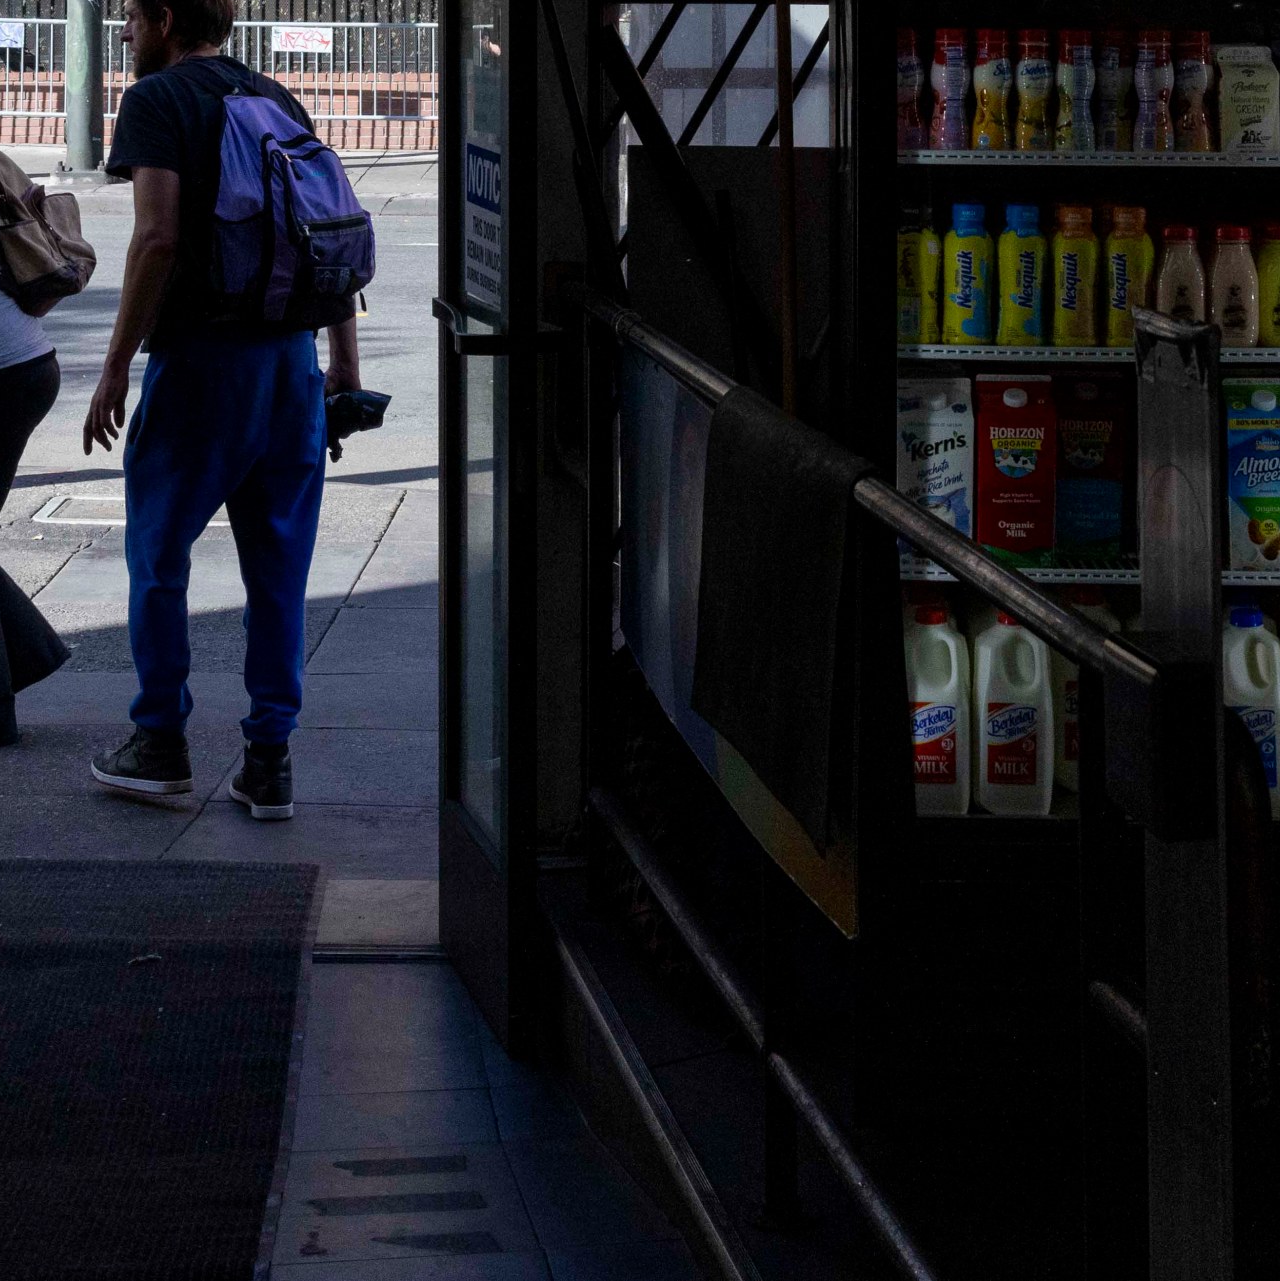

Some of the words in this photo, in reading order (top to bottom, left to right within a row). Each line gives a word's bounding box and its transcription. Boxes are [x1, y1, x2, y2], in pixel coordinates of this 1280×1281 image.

[1236, 105, 1266, 115] CREAM
[468, 154, 501, 204] NOTIC
[485, 247, 501, 272] UNLOC
[957, 251, 976, 308] Nesquik
[1019, 251, 1037, 308] Nesquik
[1063, 252, 1081, 310] Nesquik
[1113, 253, 1131, 310] Nesquik
[989, 426, 1045, 440] HORIZON
[1058, 419, 1114, 433] HORIZON
[910, 431, 968, 462] Kern's
[997, 439, 1037, 449] ORGANIC
[998, 520, 1035, 532] Organic
[1006, 529, 1027, 538] Milk
[991, 709, 1036, 734] Berkeley
[914, 761, 950, 775] MILK
[995, 762, 1030, 776] MILK
